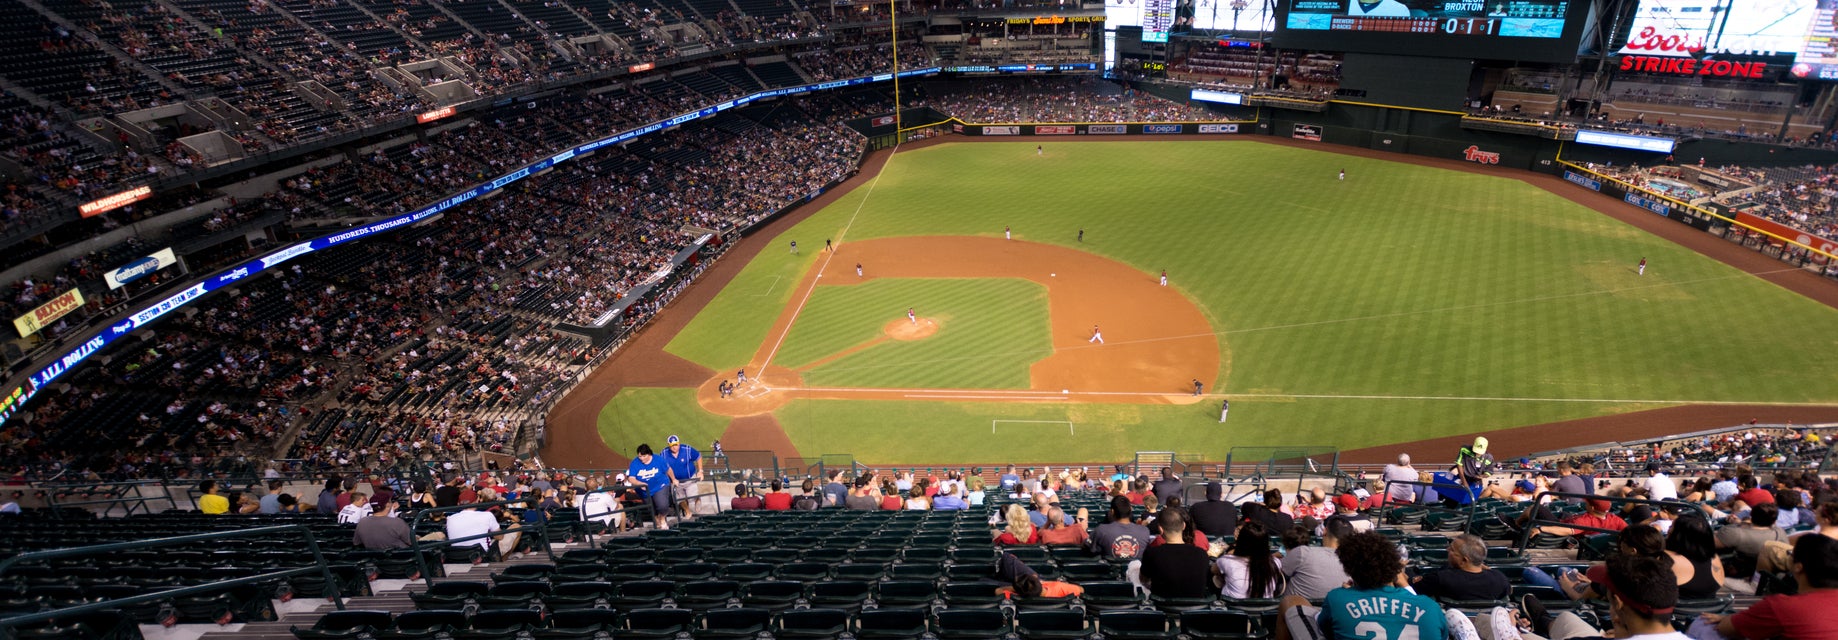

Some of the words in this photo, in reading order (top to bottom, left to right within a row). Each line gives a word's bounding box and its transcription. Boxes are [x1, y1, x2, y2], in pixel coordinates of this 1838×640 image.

[1444, 3, 1484, 11] BROXTON
[1446, 18, 1458, 34] 0
[1466, 19, 1474, 34] 1
[1487, 19, 1494, 35] 1
[1626, 26, 1705, 53] Coors
[1620, 55, 1698, 74] STRIKE
[1698, 60, 1766, 78] ZONE
[1155, 125, 1176, 133] pepsi
[1200, 125, 1238, 133] GEICO
[1628, 194, 1640, 204] COX
[1651, 202, 1665, 213] COX
[329, 228, 371, 244] HUNDREDS.
[370, 217, 412, 233] THOUSANDS.
[439, 201, 451, 212] ALL
[452, 190, 478, 206] ROLLING
[35, 292, 75, 320] SEXTON
[171, 294, 185, 306] TEAM
[42, 362, 64, 383] ALL
[62, 336, 104, 370] ROLLING
[1346, 597, 1426, 623] GRIFFEY
